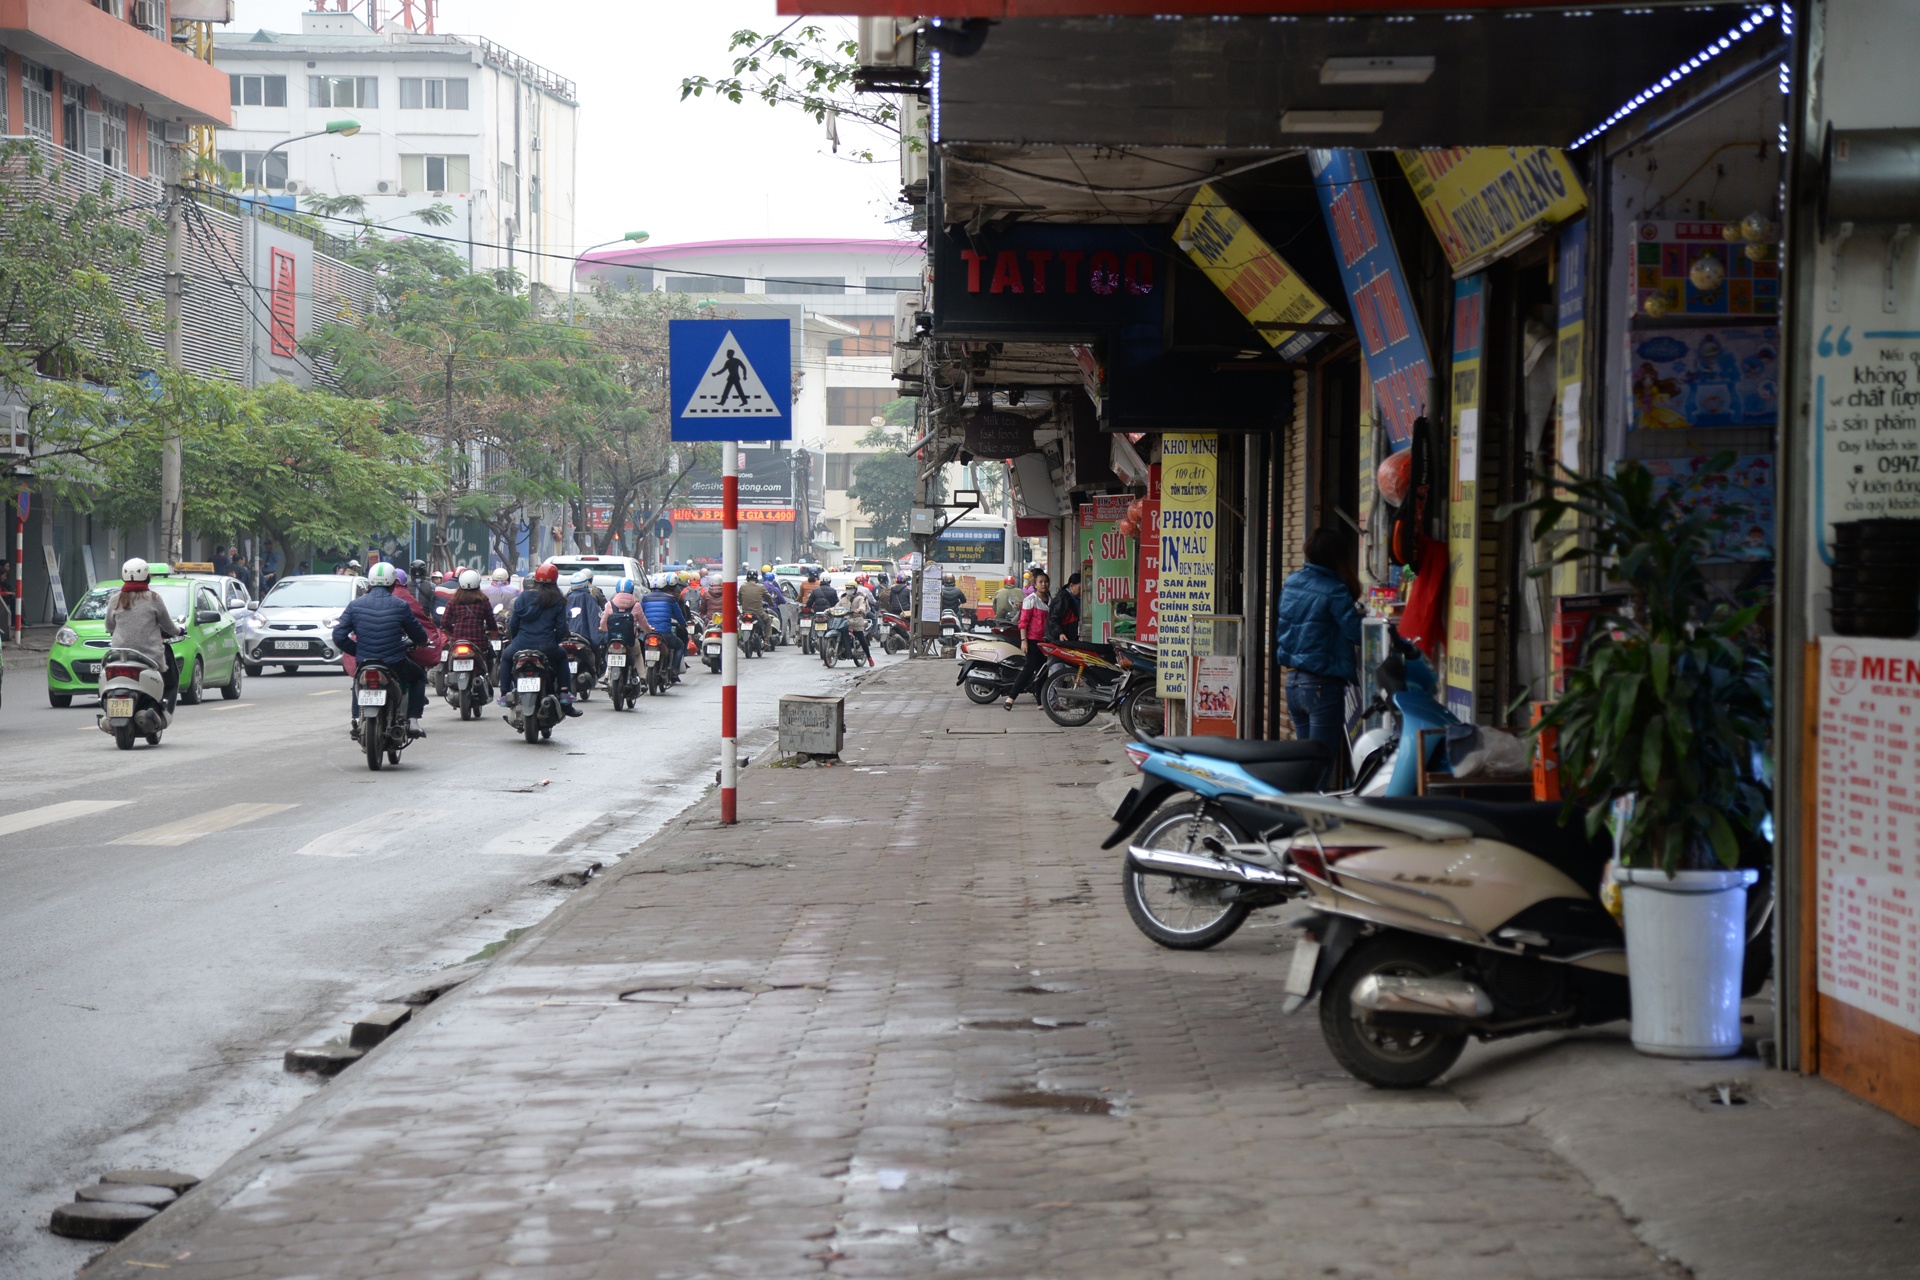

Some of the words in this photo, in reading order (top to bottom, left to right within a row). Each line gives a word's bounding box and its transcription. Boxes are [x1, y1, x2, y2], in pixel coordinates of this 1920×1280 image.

[961, 249, 1154, 296] TATTOO
[1854, 365, 1906, 391] không
[1848, 386, 1885, 407] chất
[1876, 410, 1917, 435] phẩm
[998, 427, 1019, 440] food
[1191, 439, 1217, 454] MINH
[1866, 439, 1898, 451] khách
[1175, 468, 1188, 479] 109
[1171, 483, 1181, 495] TÔN
[1181, 481, 1194, 495] THẤT
[1195, 483, 1207, 495] TÙNG
[766, 511, 795, 520] 4.490
[1163, 510, 1214, 529] PHOTO
[1101, 526, 1128, 561] SỮA
[1182, 531, 1207, 554] MÀU
[1162, 536, 1180, 572] IN
[1179, 562, 1192, 575] ĐEN
[1194, 556, 1215, 575] TRẮNG
[1163, 579, 1183, 588] SAN
[1186, 576, 1207, 588] ẢNH
[1160, 590, 1186, 599] ĐÁNH
[1189, 590, 1211, 599] MÁY
[1160, 600, 1189, 610] CHỈNH
[1191, 601, 1212, 611] SỬA
[1162, 613, 1187, 624] LUẬN
[1160, 624, 1178, 634] ĐÓNG
[1140, 633, 1148, 641] IN
[1159, 636, 1170, 645] GÁY
[1186, 637, 1198, 645] CC
[1160, 649, 1168, 657] IN
[1170, 659, 1186, 669] GIẤ
[1164, 671, 1174, 681] ÉP
[1176, 673, 1186, 681] PL
